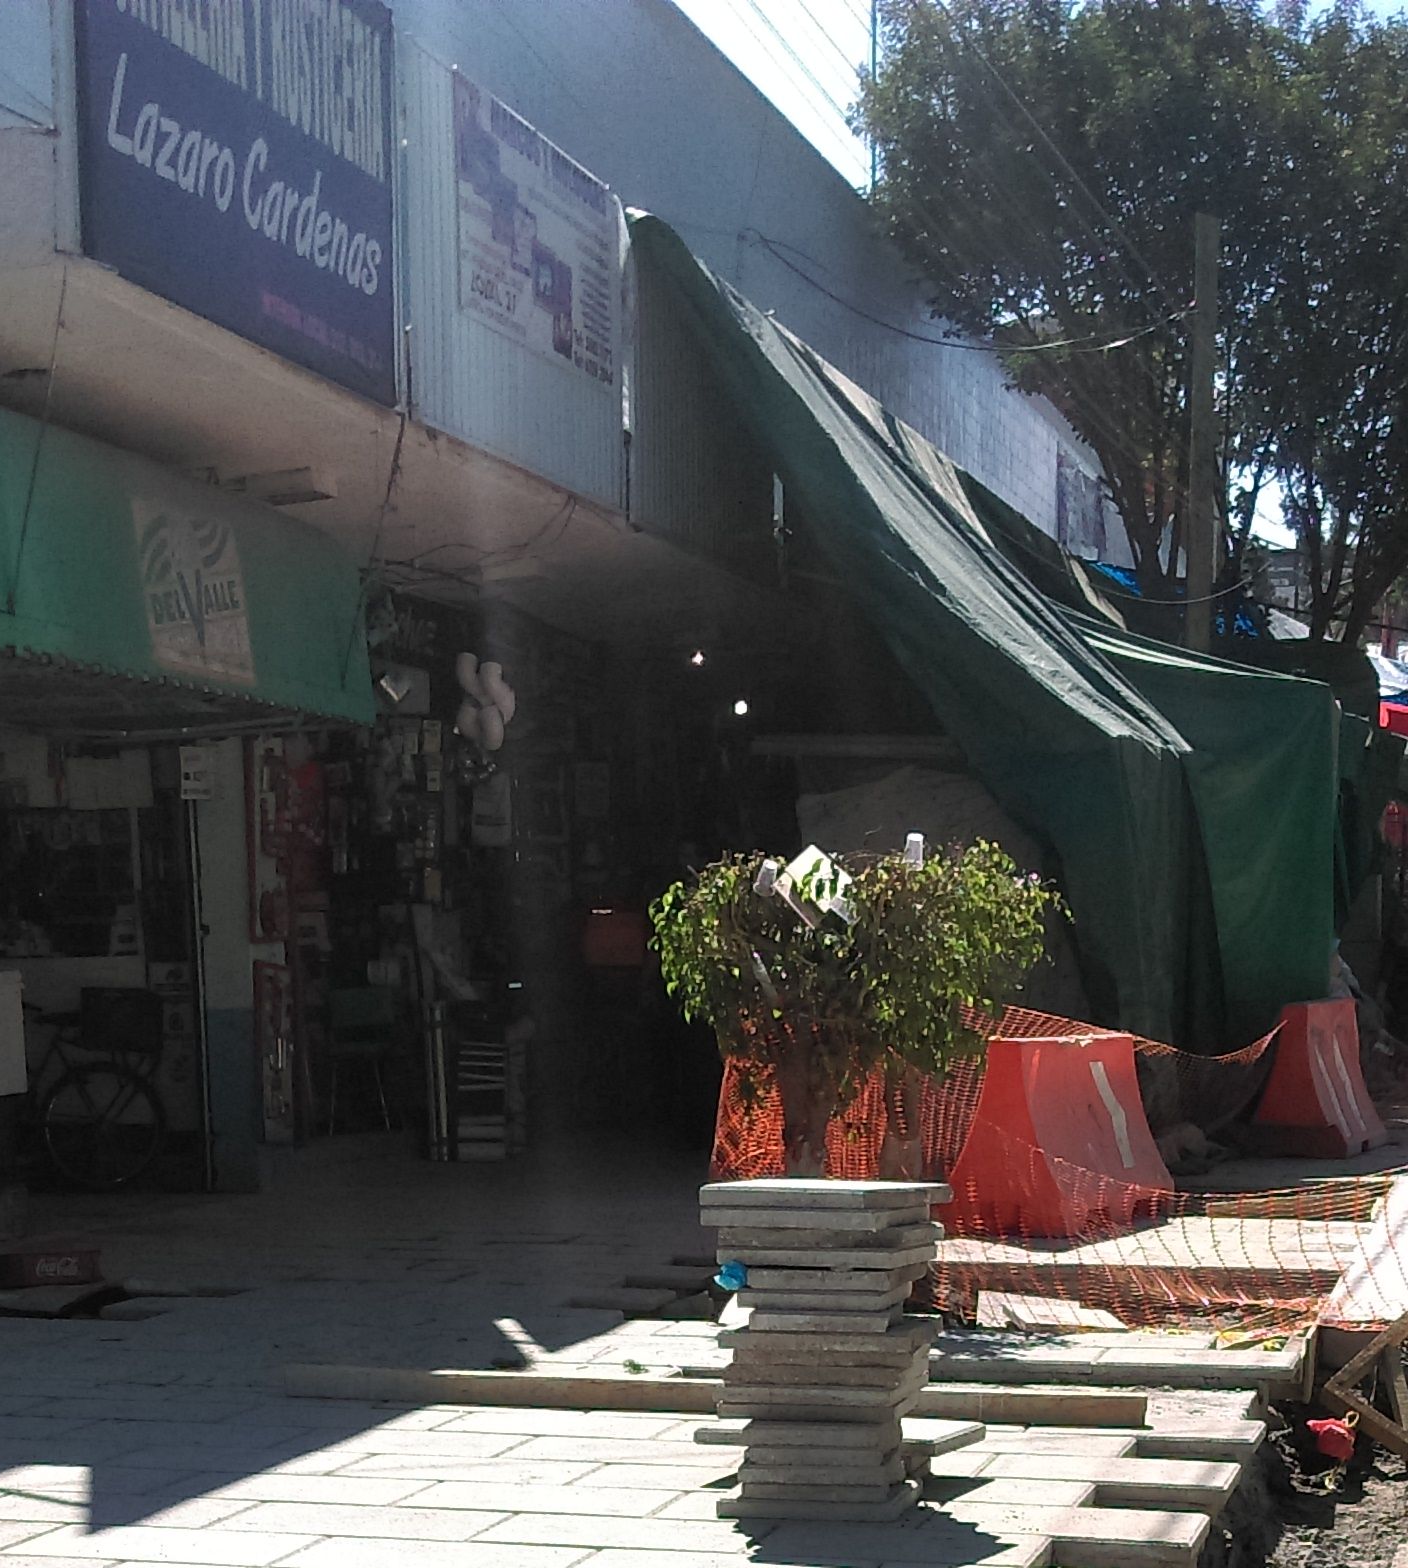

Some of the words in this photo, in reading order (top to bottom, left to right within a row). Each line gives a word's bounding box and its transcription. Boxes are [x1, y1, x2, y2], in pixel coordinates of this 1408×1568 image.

[106, 52, 236, 213] Lazaro
[242, 137, 382, 296] Cardenas
[150, 588, 188, 625] DEL
[175, 567, 241, 649] VALLE
